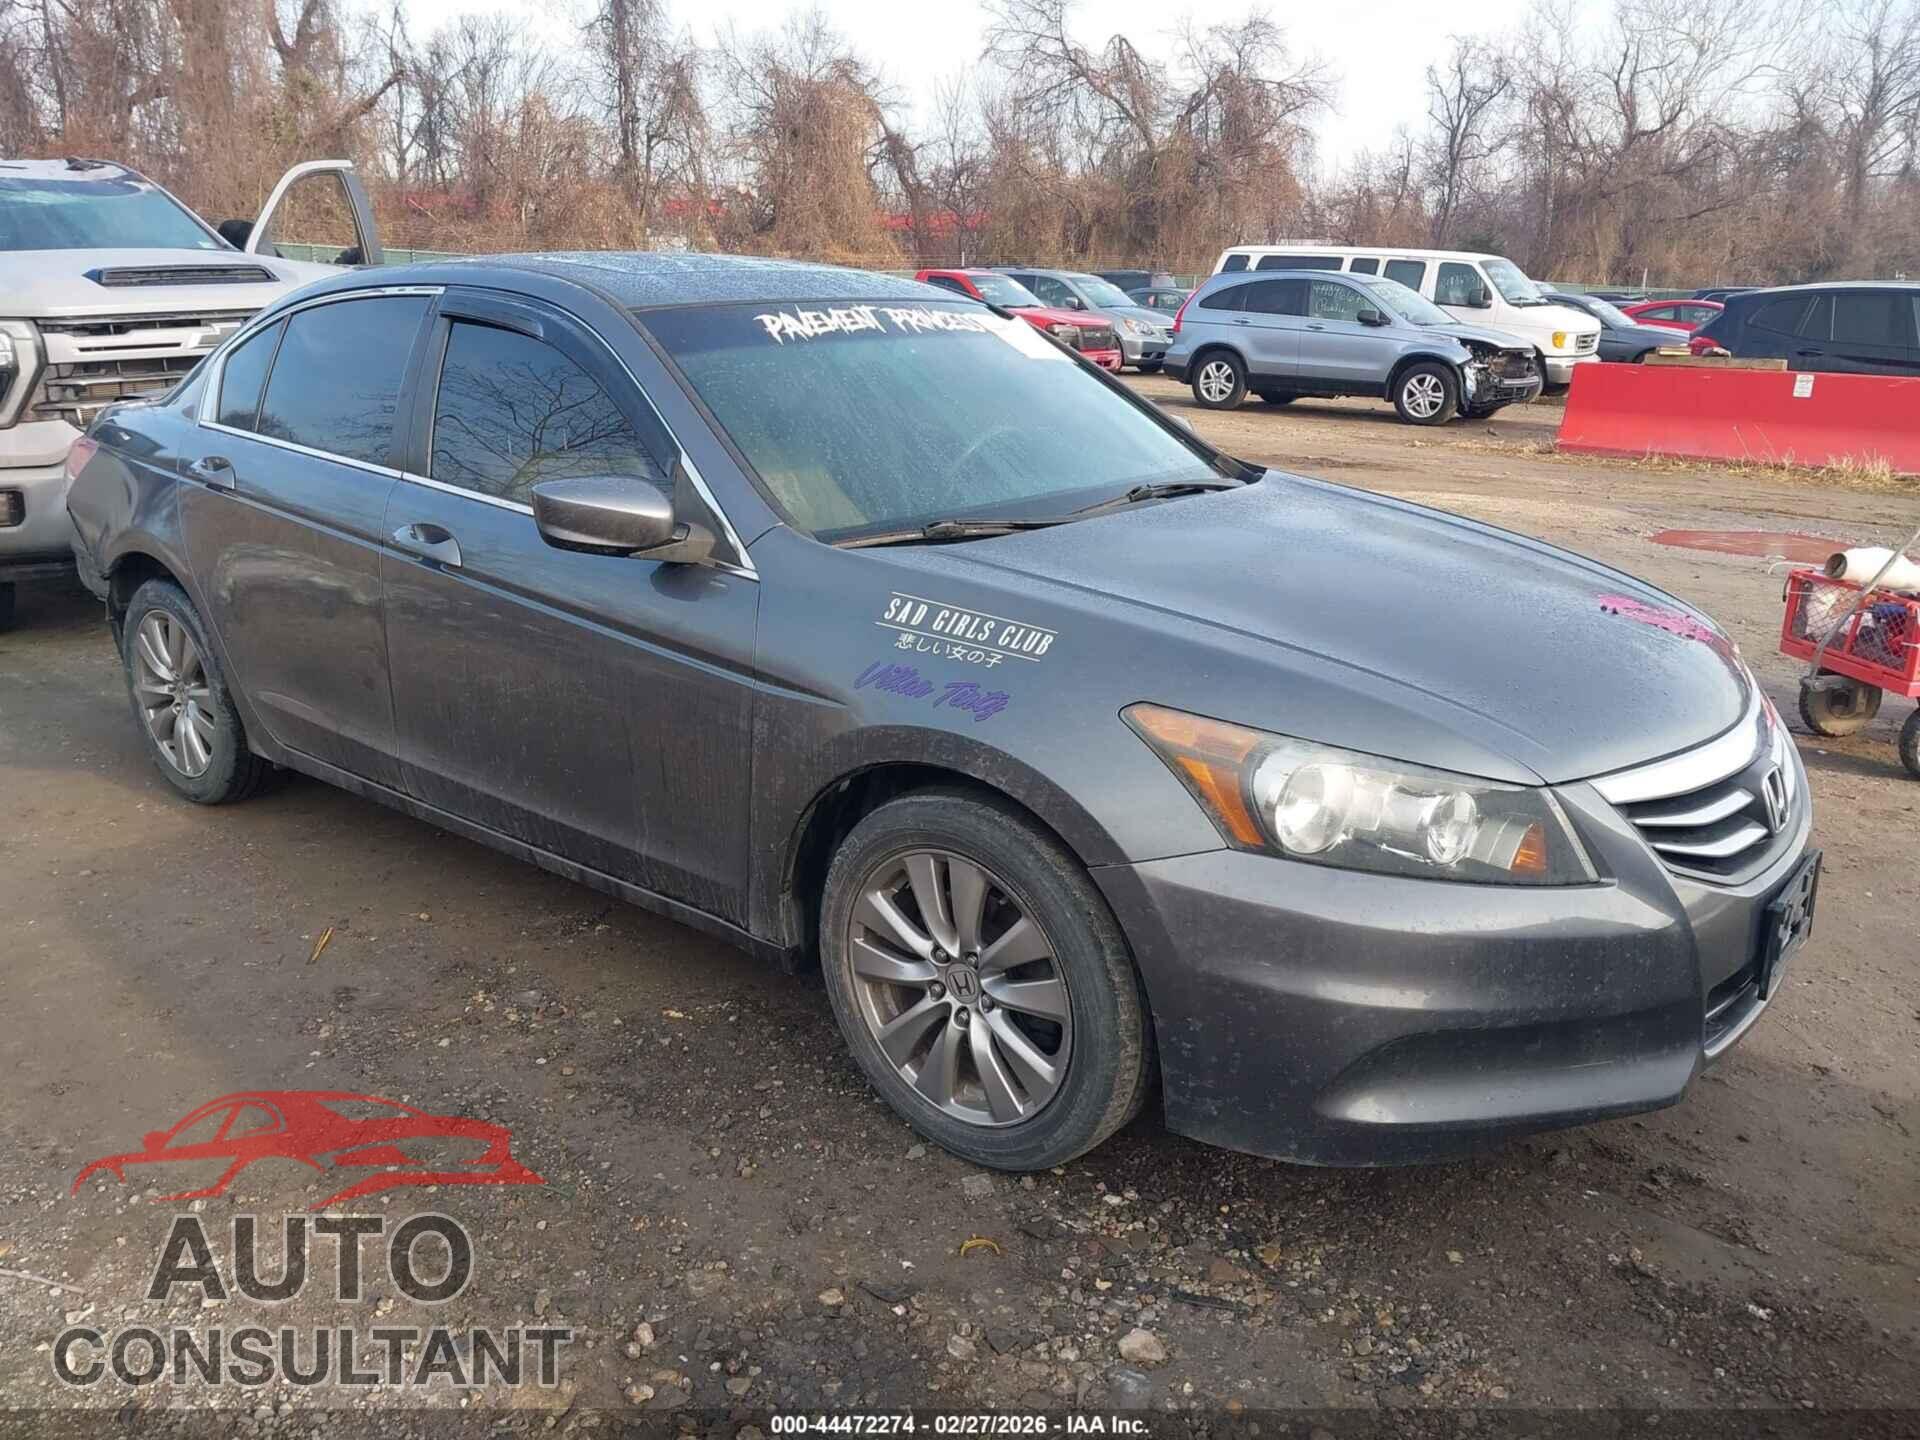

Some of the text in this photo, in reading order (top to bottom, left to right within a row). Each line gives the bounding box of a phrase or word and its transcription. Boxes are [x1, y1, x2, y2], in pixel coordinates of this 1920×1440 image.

[753, 304, 887, 345] PAVEMENT
[883, 597, 1054, 656] SAD GIRLS CLUB
[893, 632, 1004, 668] 悲しい女の子
